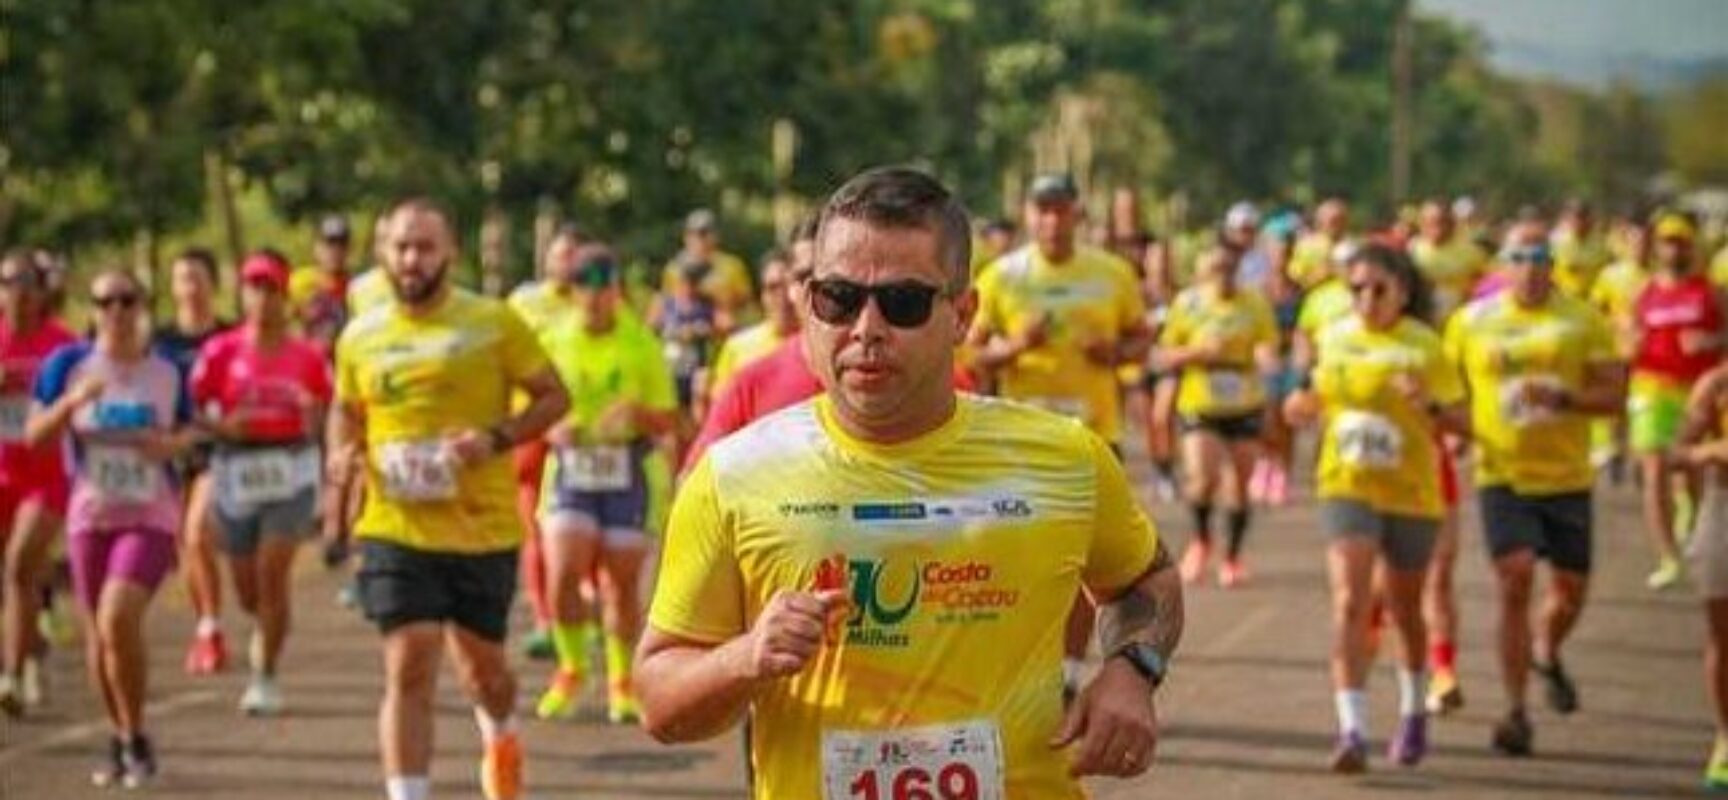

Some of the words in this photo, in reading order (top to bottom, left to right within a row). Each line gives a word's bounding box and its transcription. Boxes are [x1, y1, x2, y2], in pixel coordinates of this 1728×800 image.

[923, 560, 991, 584] Costa
[846, 627, 910, 648] Milhas
[850, 761, 979, 800] 169
